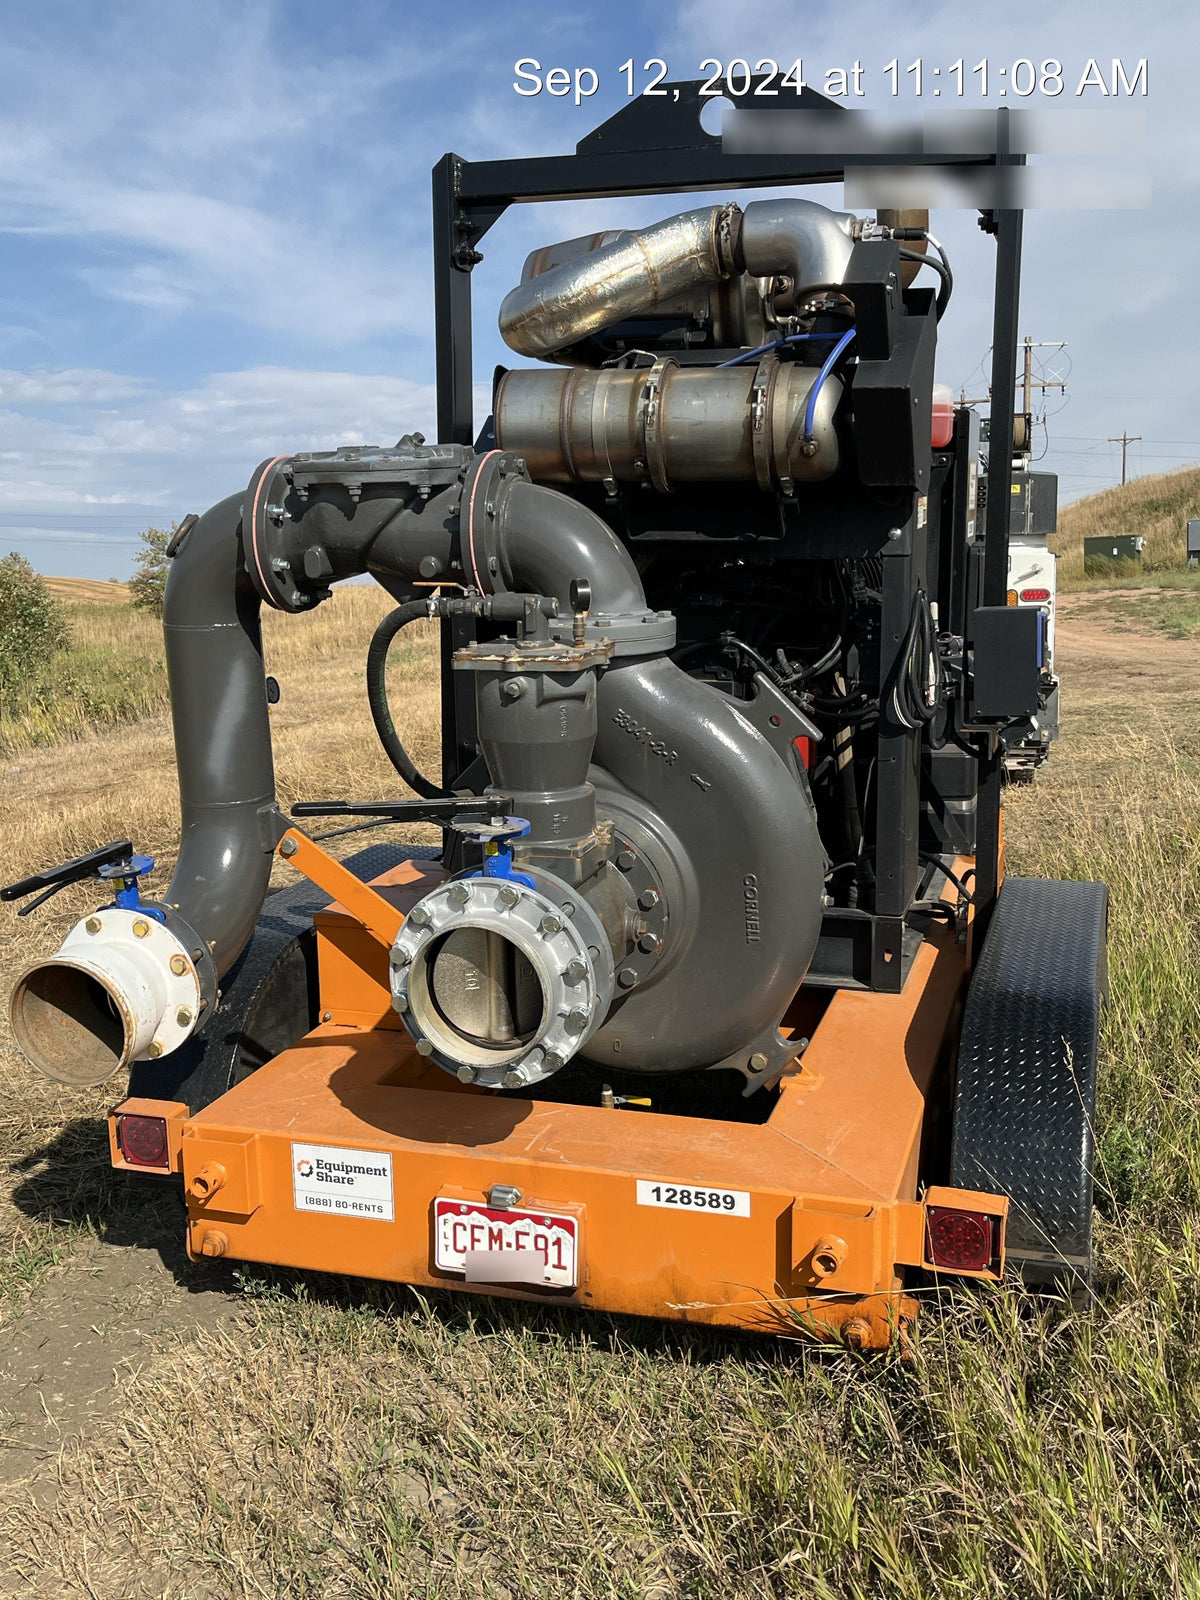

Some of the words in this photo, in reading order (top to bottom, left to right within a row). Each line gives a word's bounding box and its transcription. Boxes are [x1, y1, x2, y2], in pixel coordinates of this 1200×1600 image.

[743, 873, 761, 945] CORNELL
[315, 1158, 388, 1177] Equipment
[316, 1171, 355, 1186] Share
[305, 1195, 332, 1208] (888)
[335, 1200, 384, 1214] 80-RENTS
[651, 1186, 736, 1211] 128589
